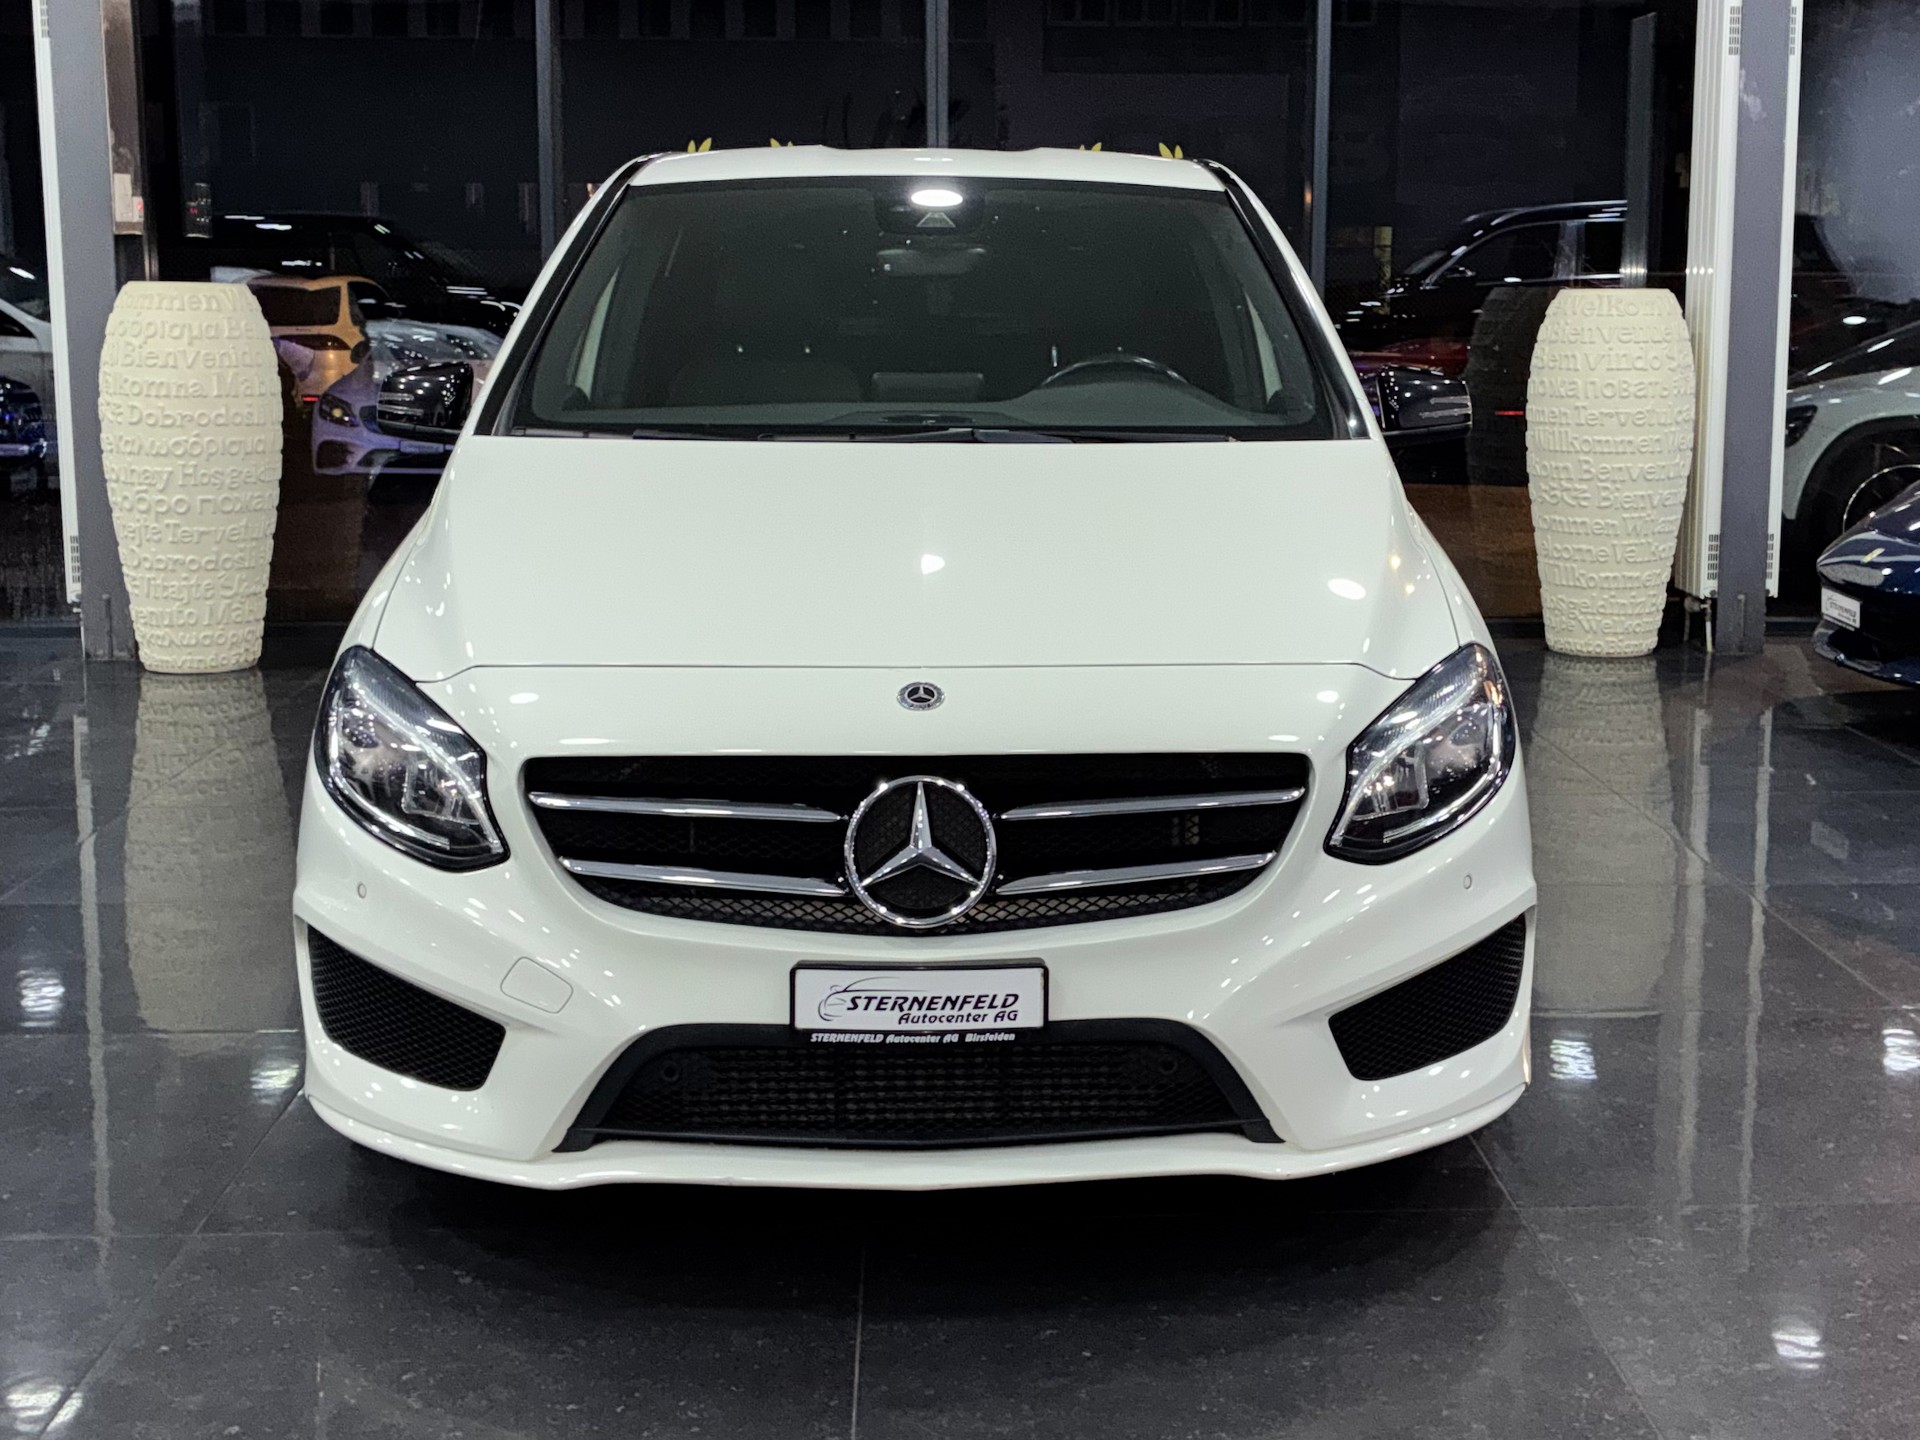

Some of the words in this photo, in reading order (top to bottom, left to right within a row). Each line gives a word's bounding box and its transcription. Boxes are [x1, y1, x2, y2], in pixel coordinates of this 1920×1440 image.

[846, 993, 1020, 1013] STERNENFELD
[897, 1010, 989, 1025] Autocenter
[993, 1010, 1019, 1022] AG
[810, 1032, 884, 1043] STERNENFELD
[885, 1033, 941, 1044] Autocenter
[943, 1033, 959, 1043] AG
[965, 1032, 1016, 1043] Birsfelden
